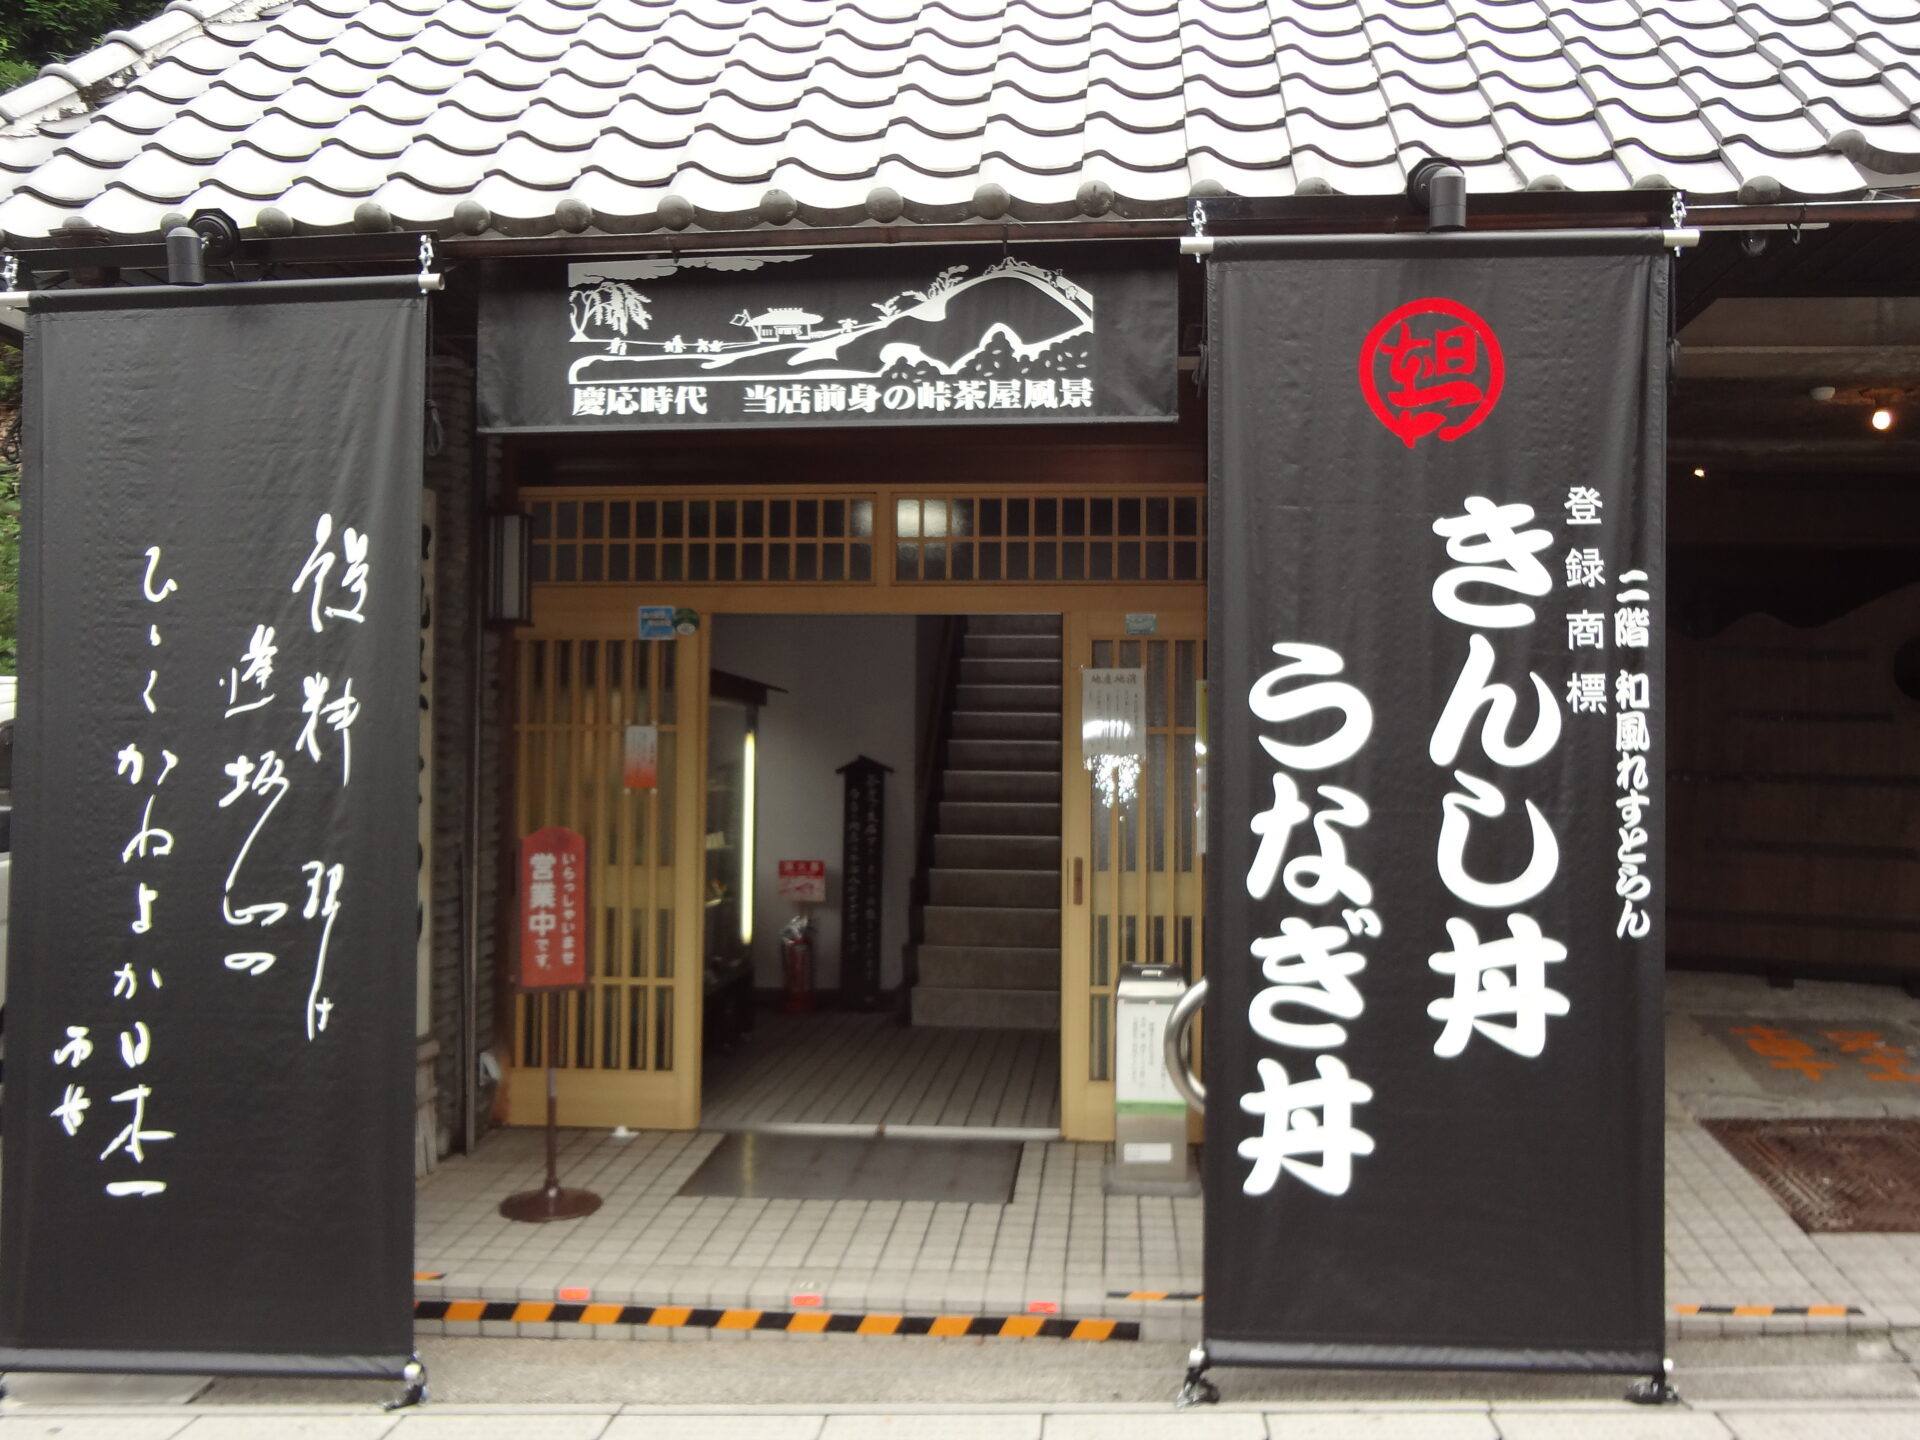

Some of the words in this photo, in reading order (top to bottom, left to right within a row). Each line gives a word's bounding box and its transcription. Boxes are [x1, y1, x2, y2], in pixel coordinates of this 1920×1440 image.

[571, 385, 709, 416] 慶応時代
[743, 377, 1095, 416] 当店前身の峠茶屋風景
[1563, 485, 1607, 714] 登録商標
[1614, 569, 1651, 648] 二階
[1427, 494, 1571, 1059] きんし丼
[1614, 669, 1653, 939] 和風れすとらん
[561, 852, 577, 966] いらっしゃいませ
[1237, 641, 1383, 1197] うなぎ丼
